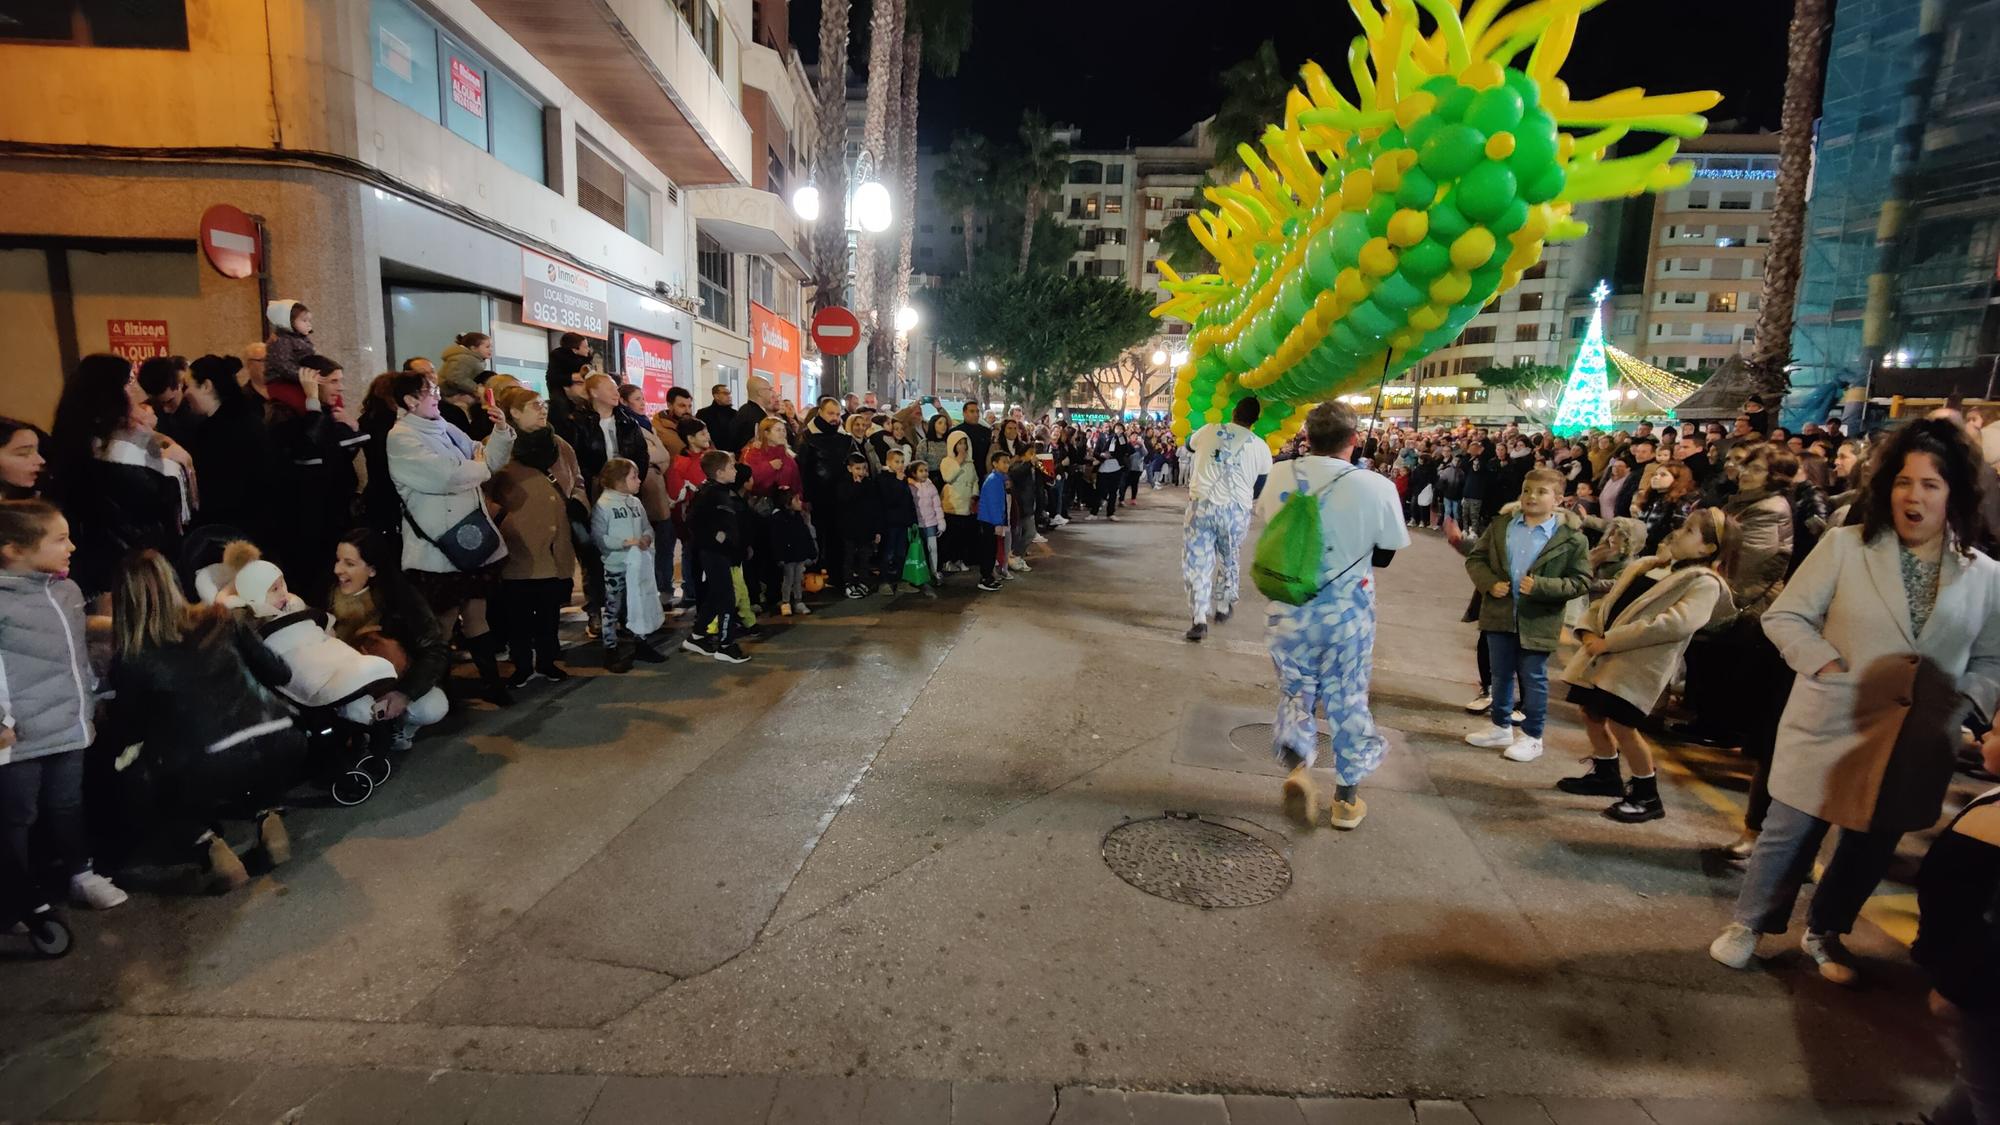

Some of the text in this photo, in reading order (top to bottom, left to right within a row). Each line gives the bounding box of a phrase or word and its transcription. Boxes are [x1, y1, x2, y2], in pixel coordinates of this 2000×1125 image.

[453, 79, 481, 106] ALQUILA
[544, 288, 594, 312] LOCAL DISPONIBLE
[534, 301, 602, 333] 963 385 484
